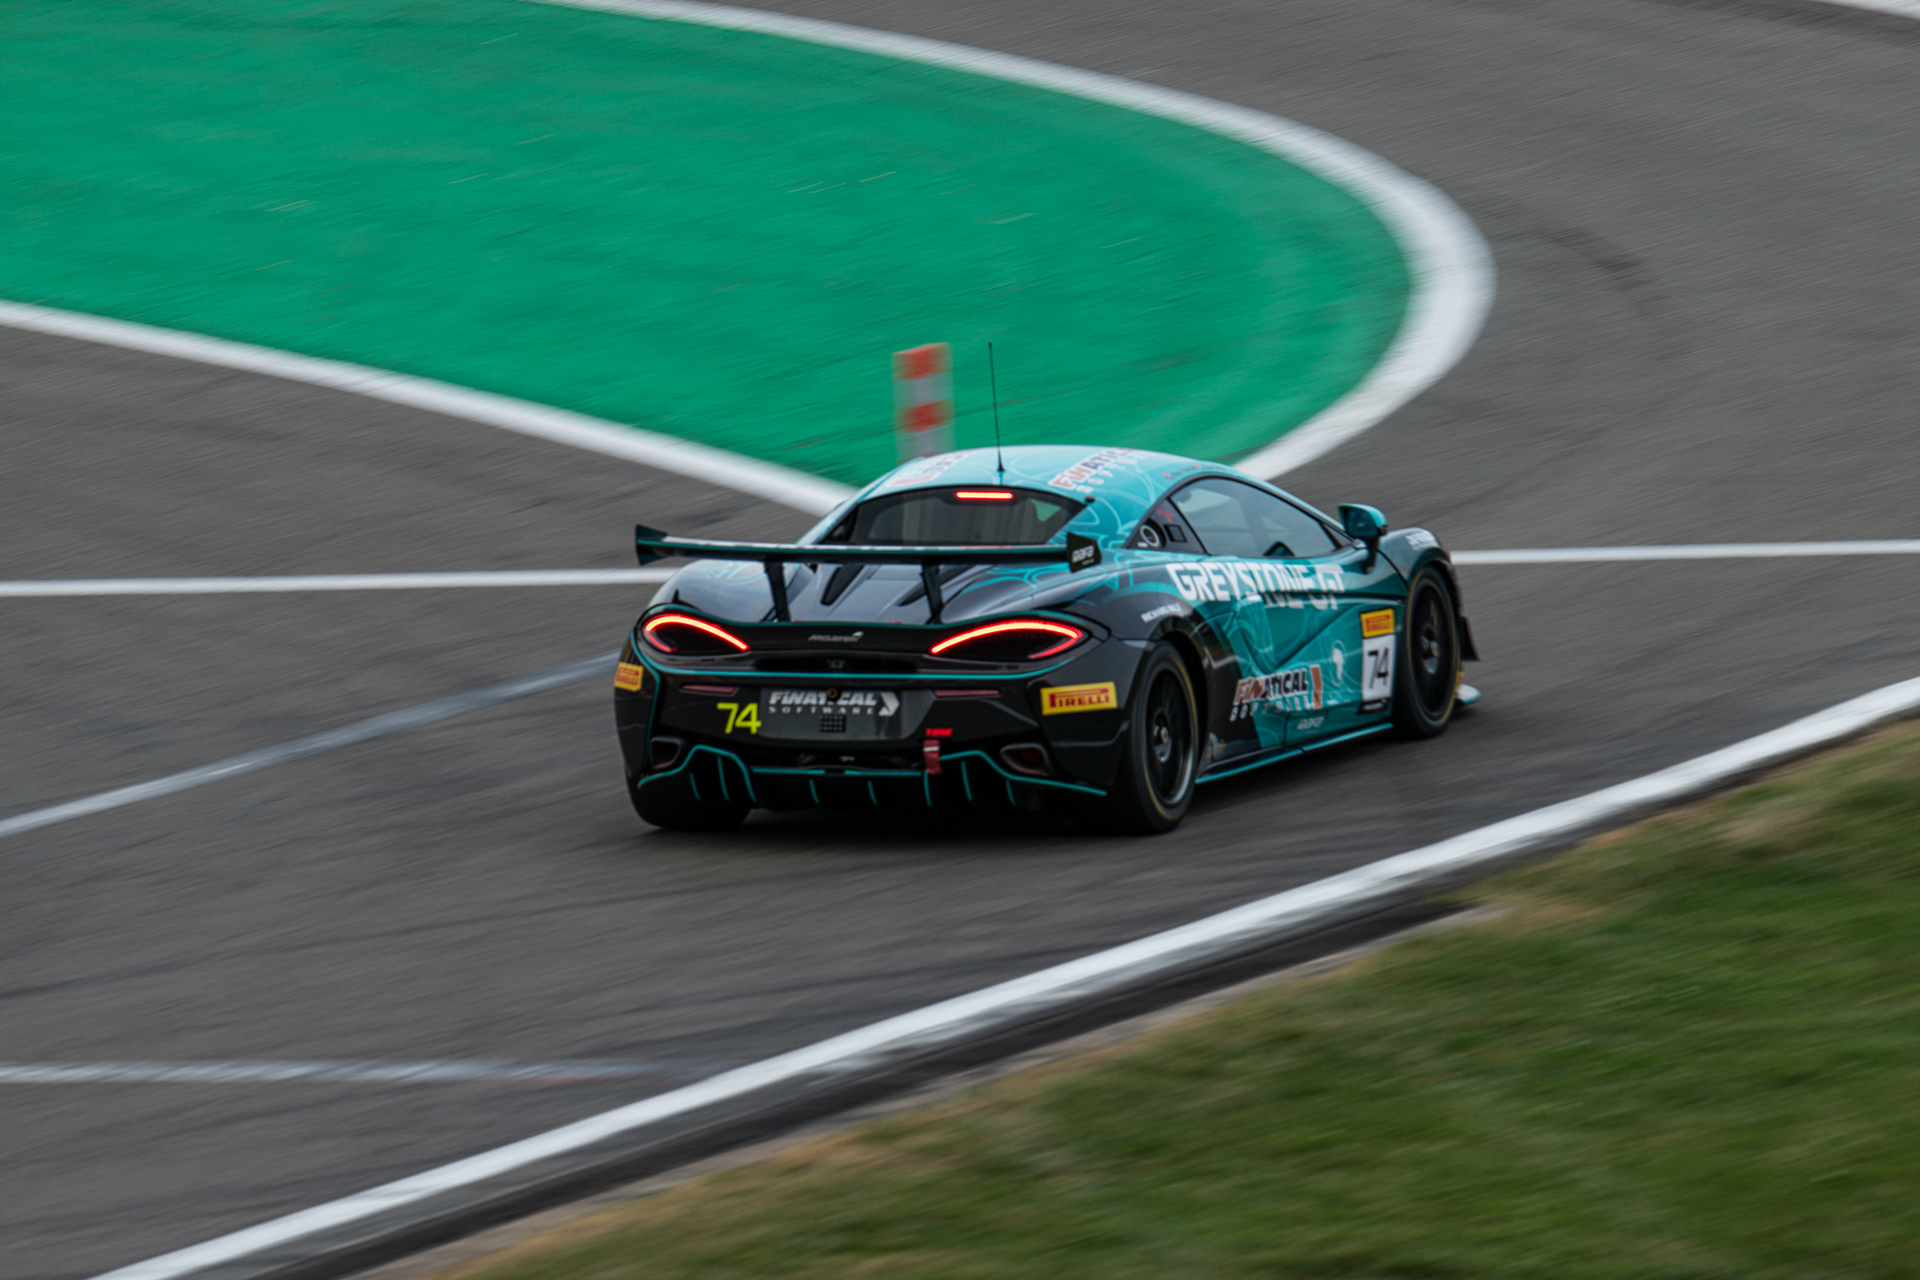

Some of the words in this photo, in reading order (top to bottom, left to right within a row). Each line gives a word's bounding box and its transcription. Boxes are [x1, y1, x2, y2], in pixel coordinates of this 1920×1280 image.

[1367, 647, 1389, 689] 74
[768, 706, 875, 714] SOFTWARE
[1049, 688, 1110, 708] PIRELLI
[717, 702, 762, 734] 74
